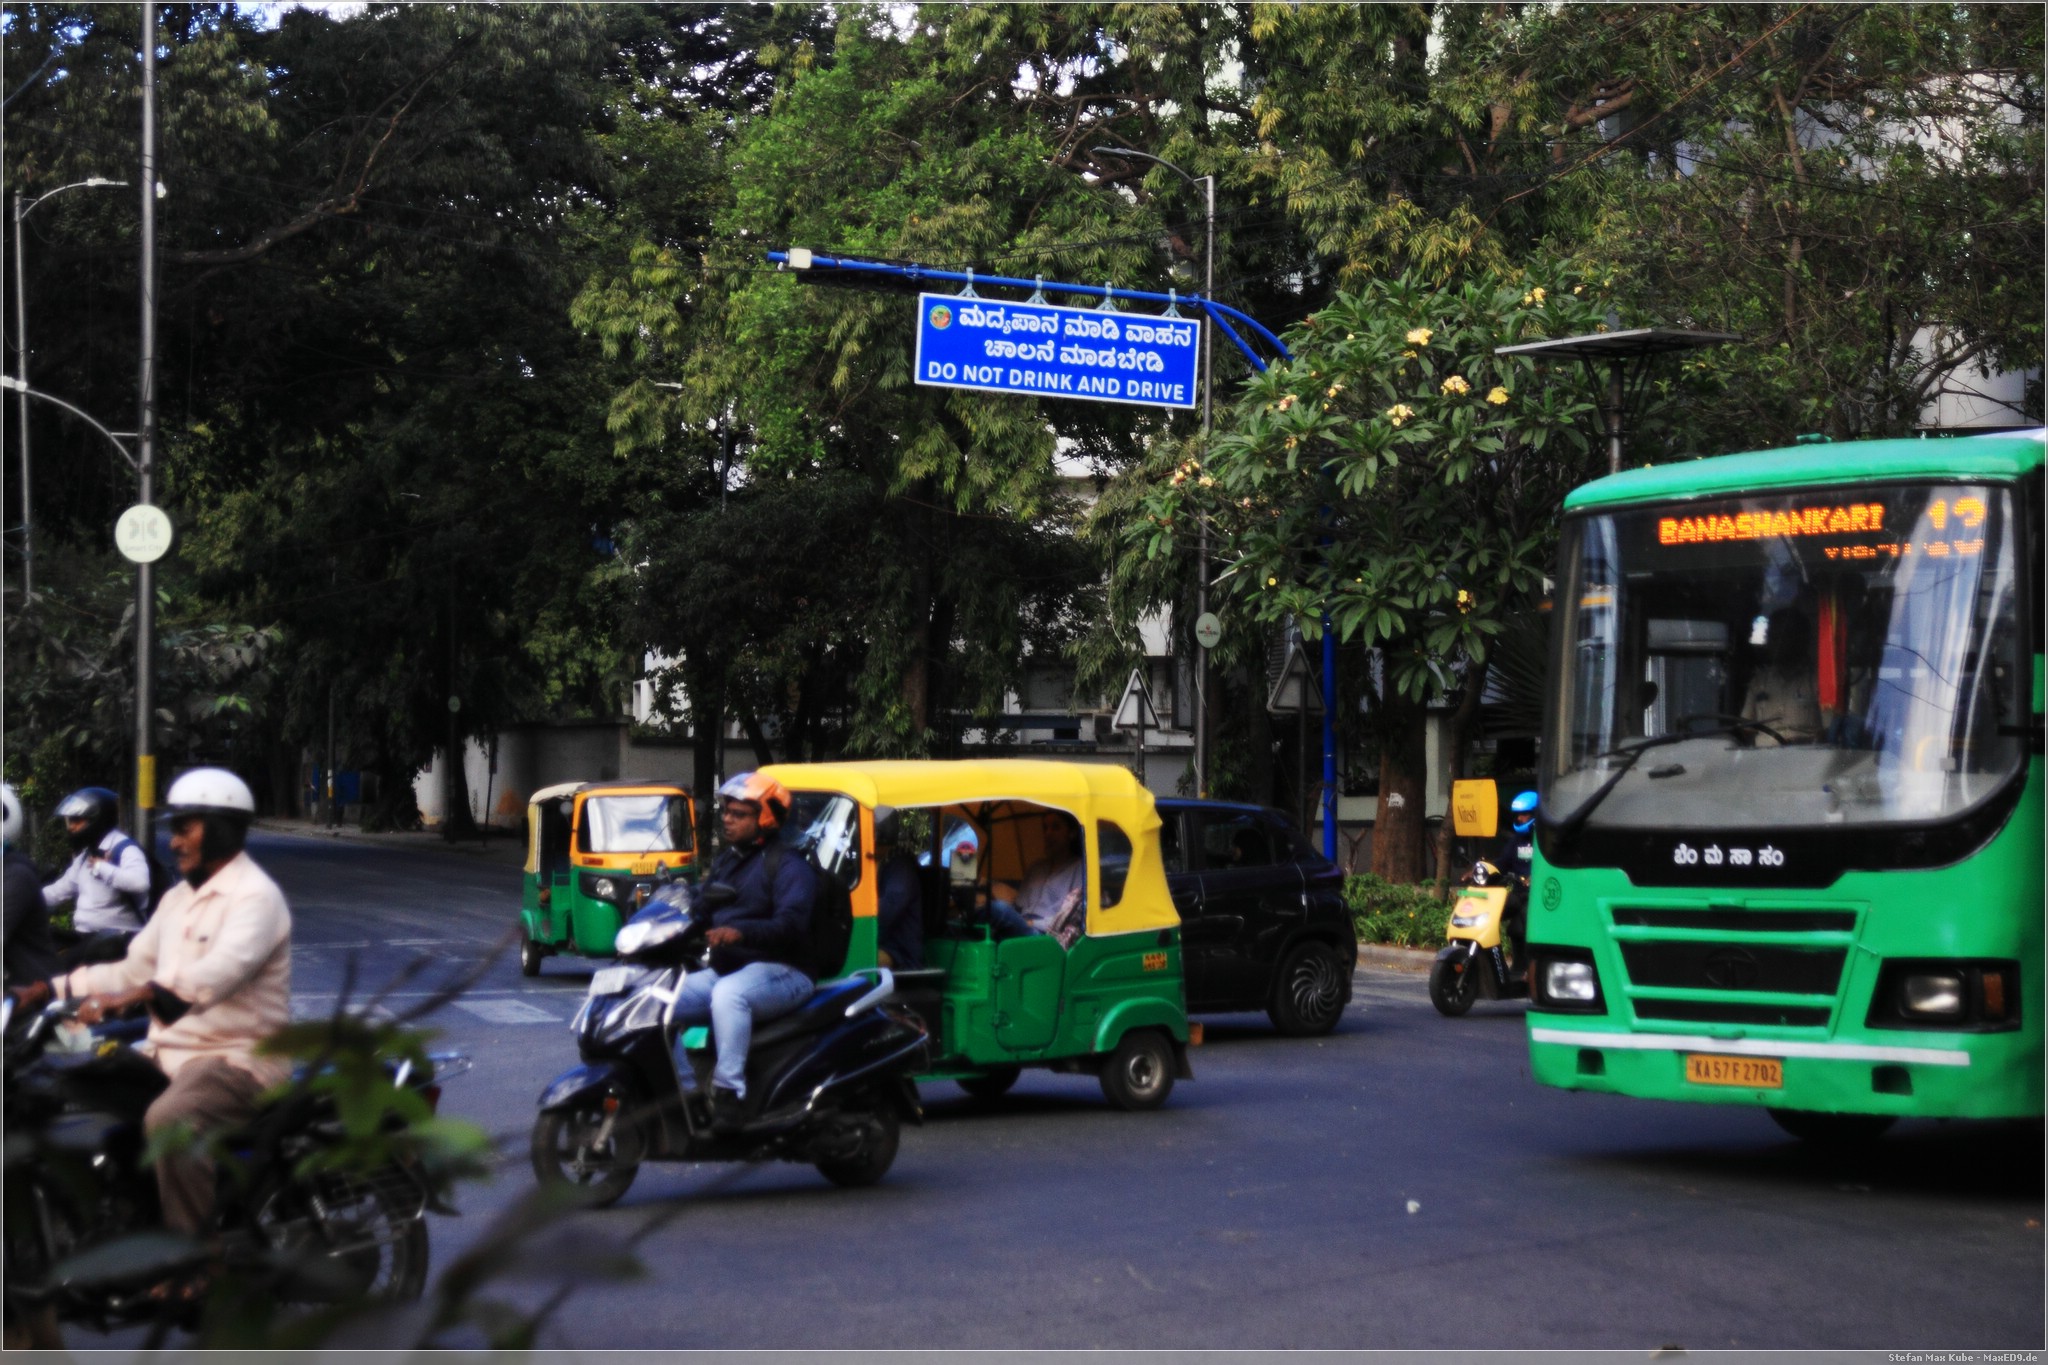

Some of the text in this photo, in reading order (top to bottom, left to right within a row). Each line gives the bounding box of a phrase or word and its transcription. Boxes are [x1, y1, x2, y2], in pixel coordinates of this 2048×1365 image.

[959, 304, 1192, 347] ಮದ್ಯಪಾನ ಮಾಡಿ ವಾಹನ
[984, 338, 1164, 373] ಚಾಲನೆ ಮಾಡಬೇಡಿ
[928, 361, 1184, 401] DO NOT DRINK AND DRIVE
[1658, 503, 1885, 545] BANASHANKARI
